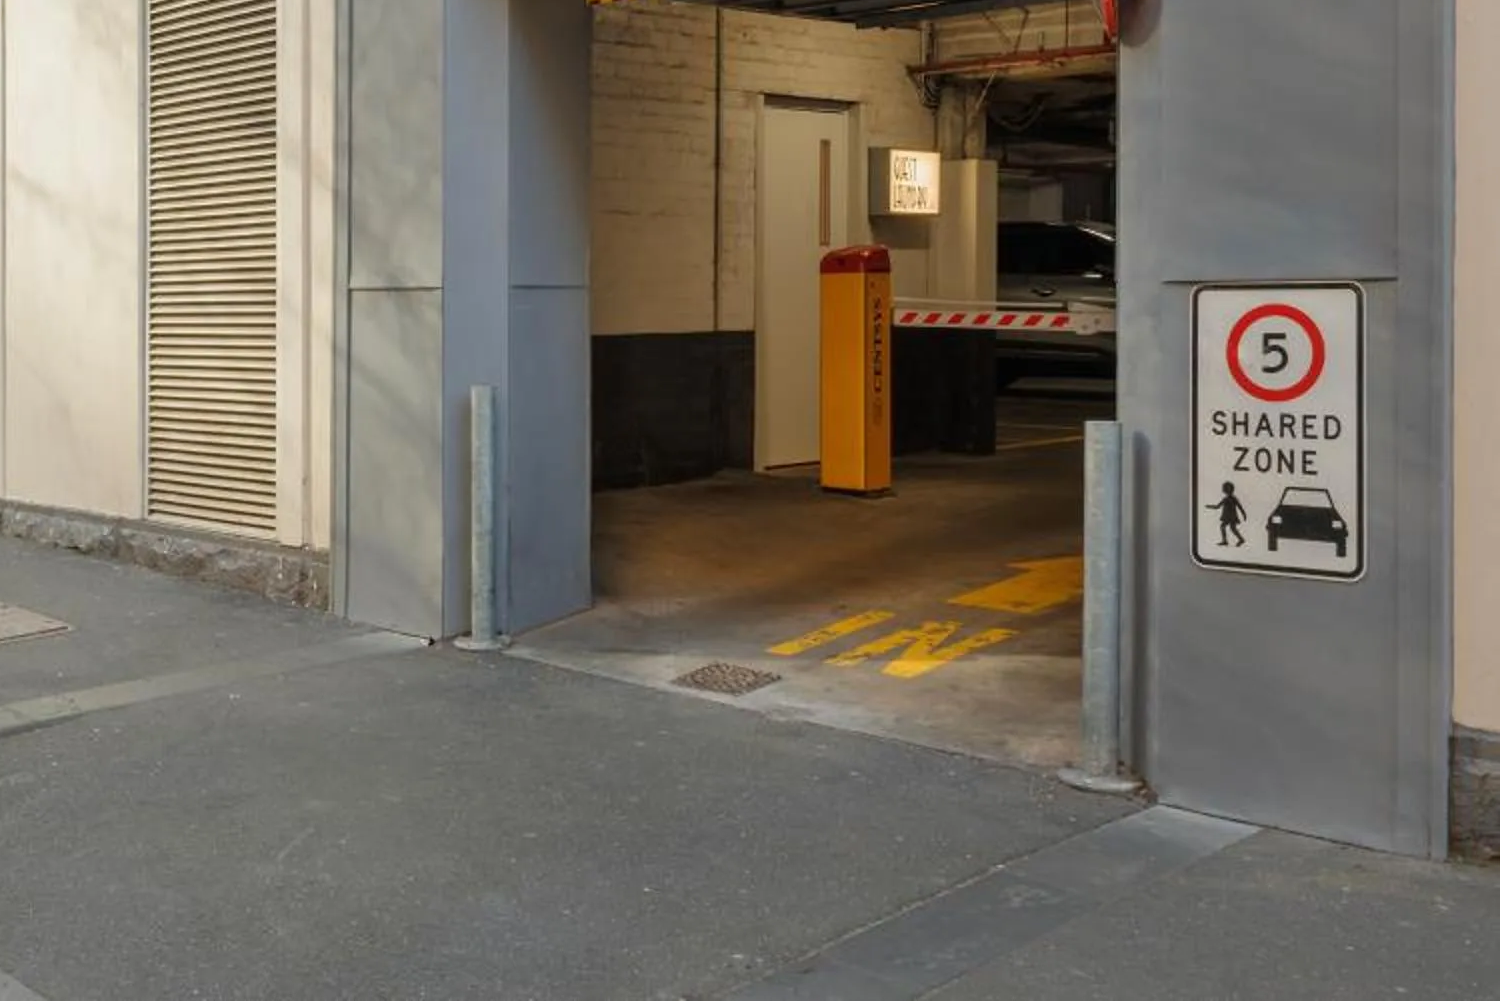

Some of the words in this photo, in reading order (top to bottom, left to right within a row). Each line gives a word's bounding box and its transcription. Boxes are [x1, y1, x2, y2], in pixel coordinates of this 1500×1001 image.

[1261, 332, 1290, 374] 5
[1211, 410, 1342, 441] SHARED
[1232, 446, 1319, 476] ZONE
[766, 609, 1020, 679] IN
